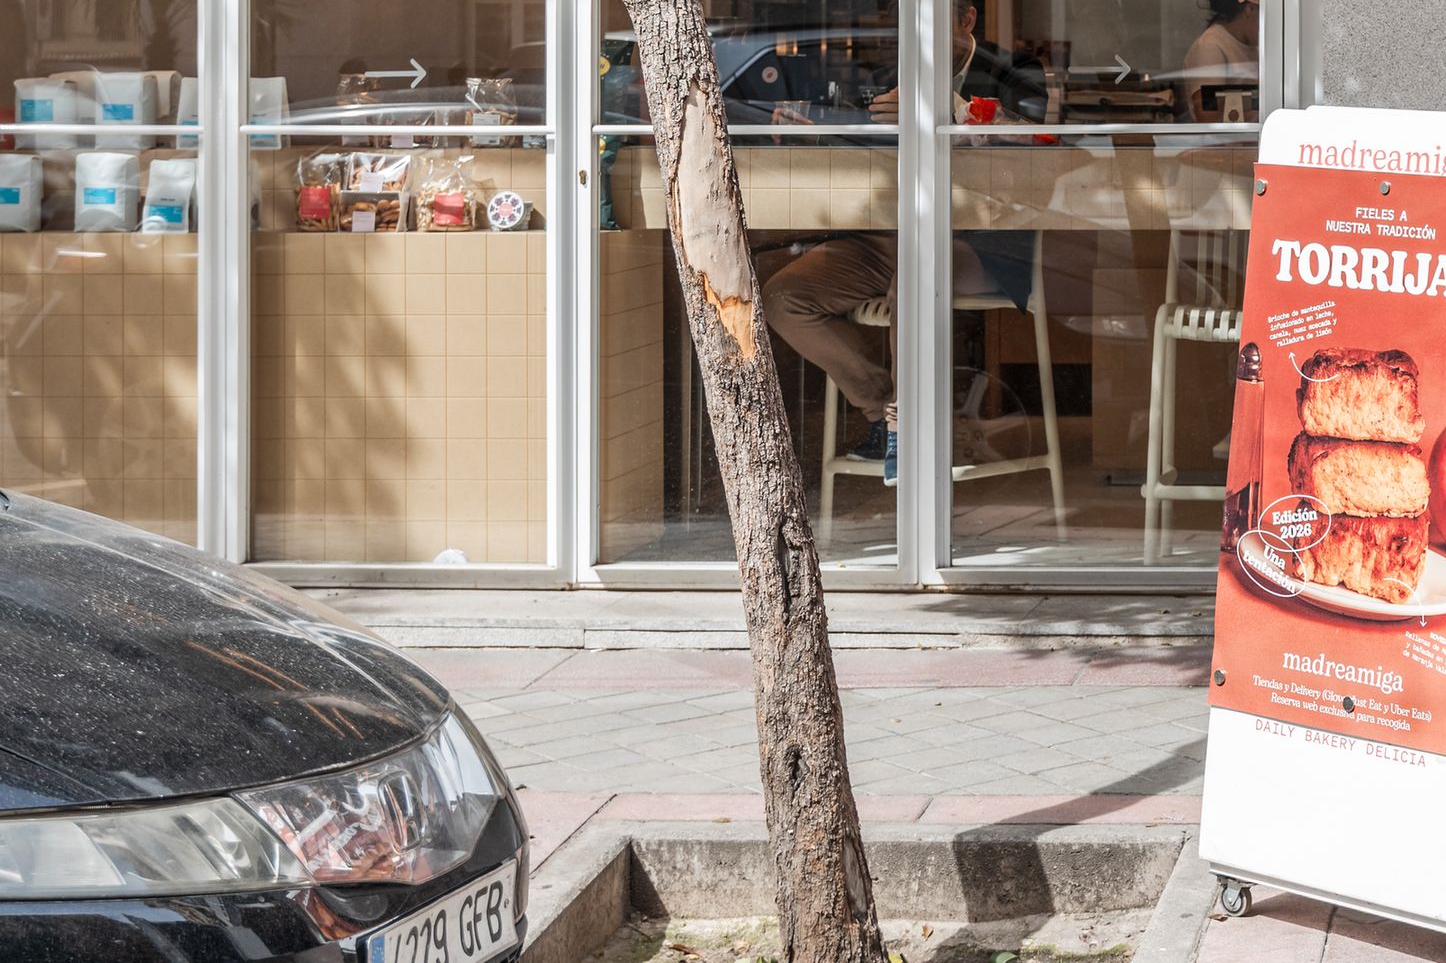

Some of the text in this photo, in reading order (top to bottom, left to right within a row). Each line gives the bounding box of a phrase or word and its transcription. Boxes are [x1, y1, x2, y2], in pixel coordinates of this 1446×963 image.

[1326, 220, 1436, 240] NUESTRA TRADICIÓN
[1355, 207, 1407, 221] FIELES A
[1272, 508, 1318, 525] Edición
[1243, 550, 1296, 594] tentación
[1264, 544, 1285, 569] Una
[1282, 652, 1404, 694] madreamiga
[1253, 675, 1283, 691] Tiendas
[1283, 684, 1290, 693] y
[1291, 683, 1321, 699] Delivery
[1369, 698, 1382, 711] Eat
[1383, 704, 1389, 713] y
[1390, 703, 1410, 717] Uber
[1271, 692, 1301, 708] Reserva
[1302, 700, 1318, 712] web
[1356, 712, 1375, 725] para
[1376, 716, 1411, 732] recogida
[1255, 719, 1426, 767] DAILY BAKERY DELICIA
[459, 880, 504, 957] GFB
